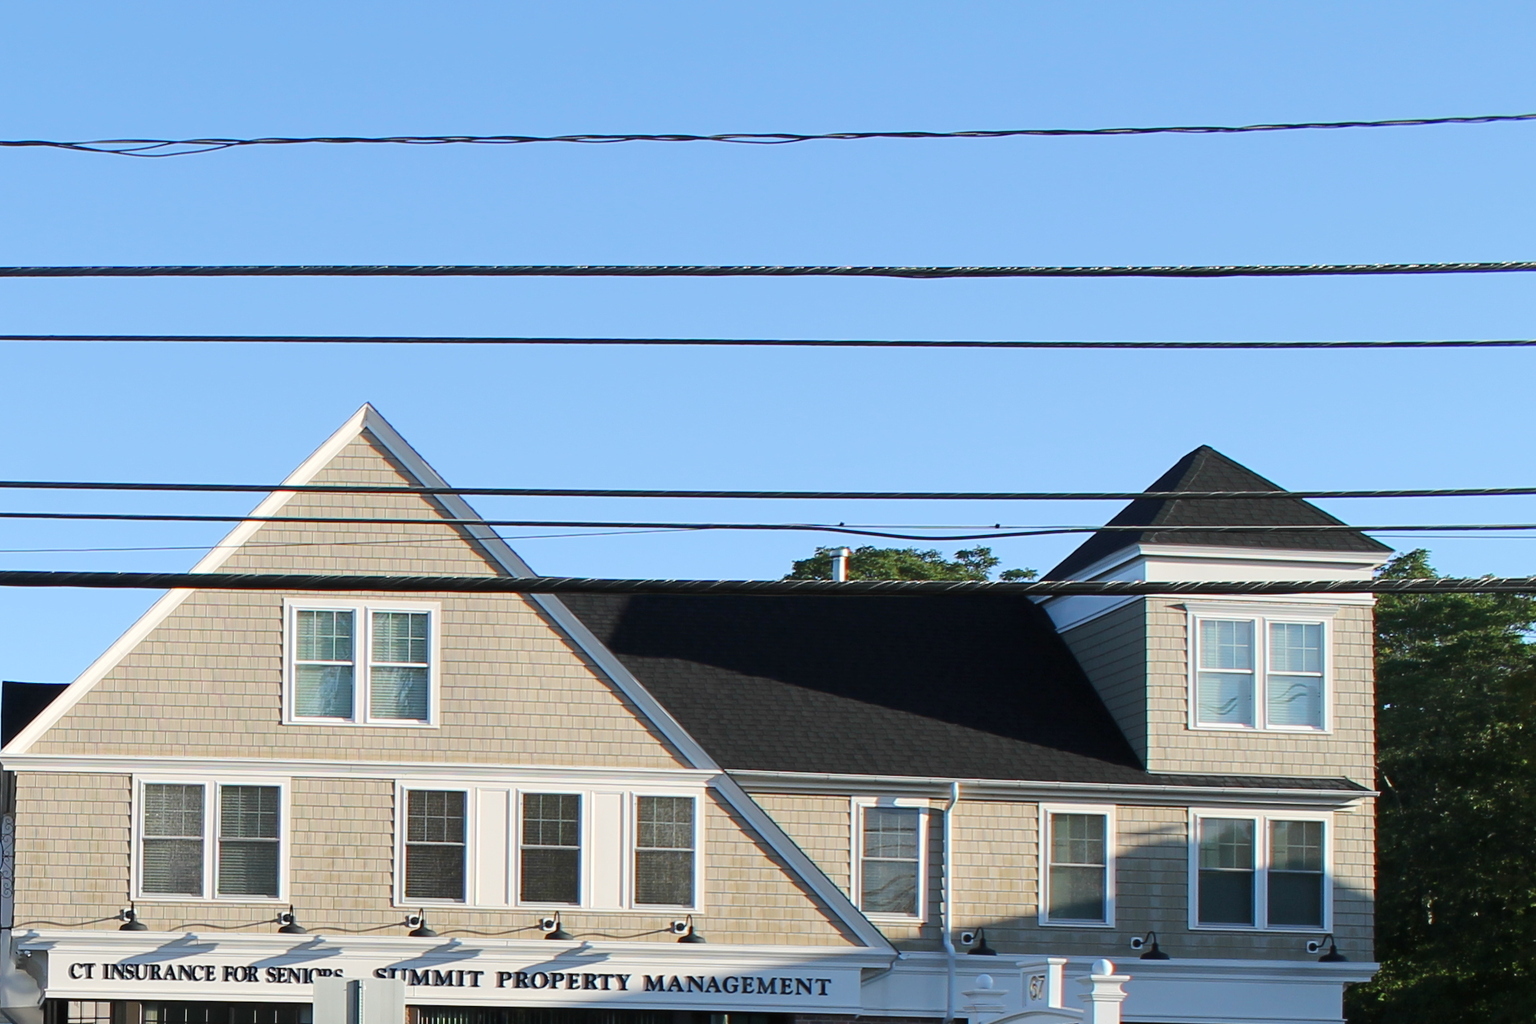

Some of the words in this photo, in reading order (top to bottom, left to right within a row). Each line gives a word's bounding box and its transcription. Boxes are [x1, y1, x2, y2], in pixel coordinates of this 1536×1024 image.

[68, 963, 96, 980] CT
[102, 964, 216, 982] INSURANCE
[222, 965, 260, 983] FOR
[496, 971, 631, 991] PROPERTY
[642, 974, 832, 996] MANAGEMENT
[1030, 975, 1045, 1001] 67
